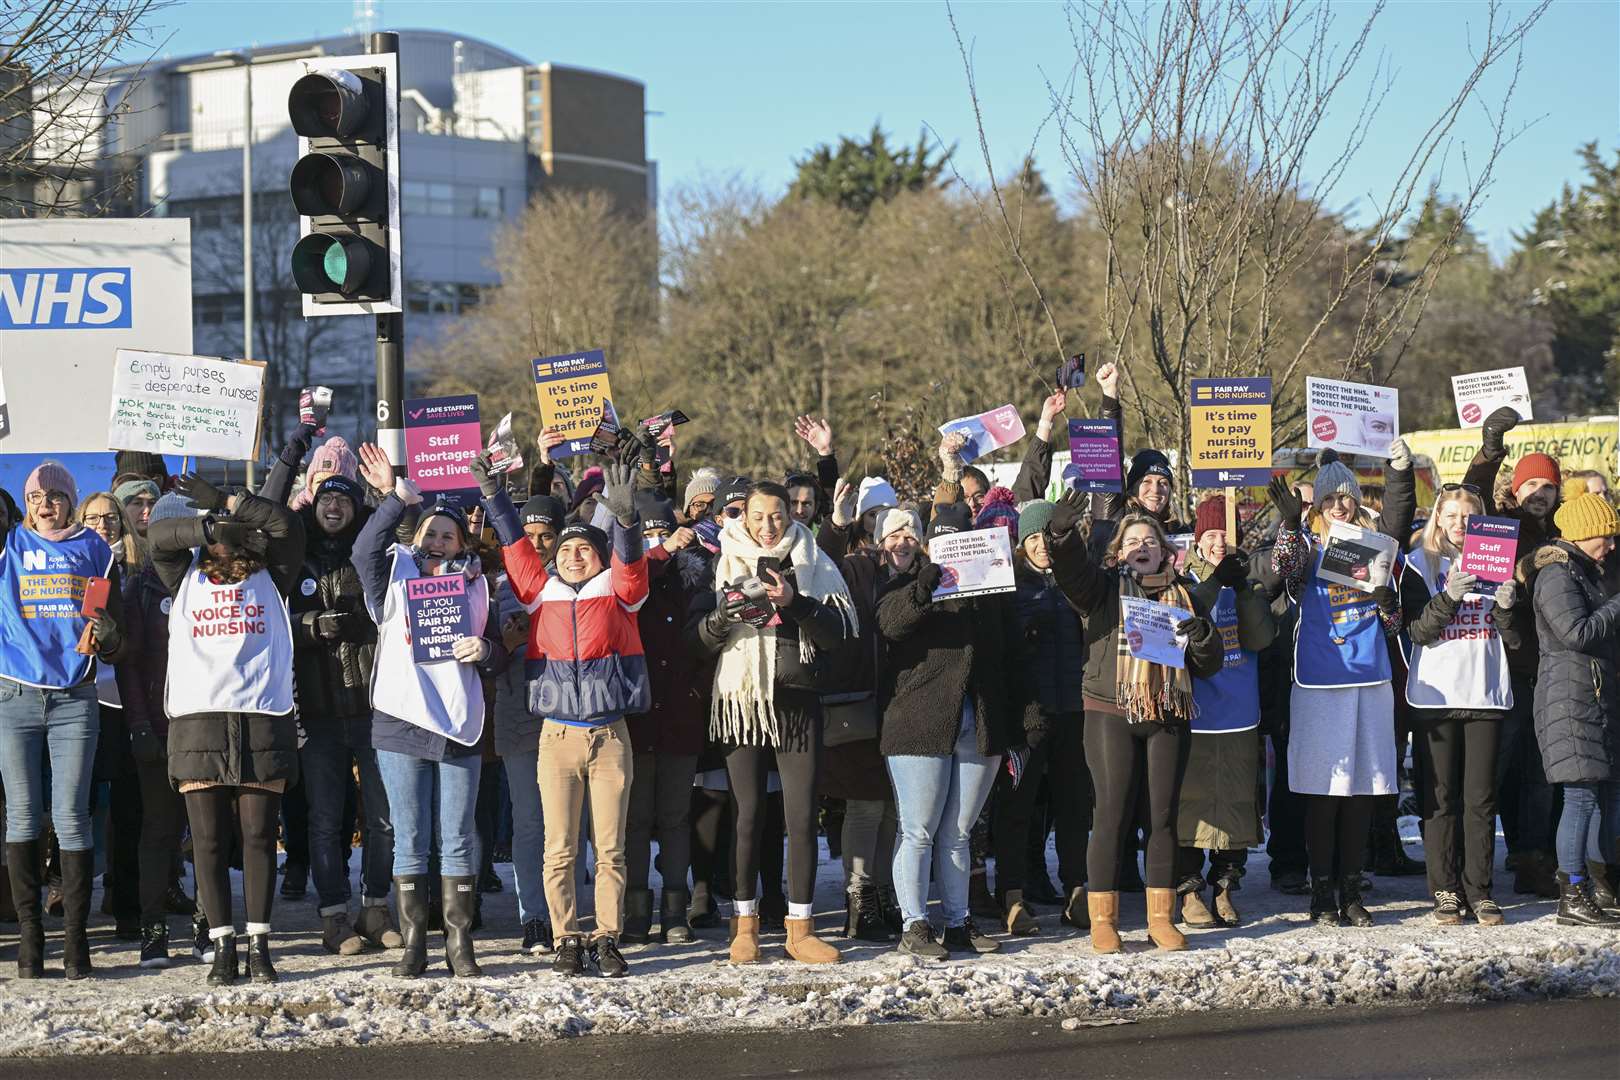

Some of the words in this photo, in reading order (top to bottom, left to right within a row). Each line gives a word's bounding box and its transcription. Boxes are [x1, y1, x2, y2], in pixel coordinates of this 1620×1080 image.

[0, 273, 125, 324] NHS
[570, 362, 602, 372] NURSING
[571, 358, 585, 366] PAY
[130, 360, 171, 380] Empty
[183, 365, 226, 383] purses
[145, 380, 211, 397] desperate
[220, 385, 258, 402] nurses
[548, 385, 567, 396] It's
[570, 382, 598, 393] time
[1312, 383, 1339, 392] PROTECT
[556, 398, 569, 407] to
[573, 395, 594, 406] pay
[1312, 391, 1339, 399] PROTECT
[1341, 394, 1371, 404] NURSING.
[149, 402, 176, 410] Nurse
[377, 400, 390, 421] 6
[426, 406, 443, 414] SAFE
[444, 404, 475, 412] STAFFING
[1312, 398, 1339, 408] PROTECT
[1354, 404, 1378, 413] PUBLIC.
[447, 410, 465, 418] LIVES
[554, 406, 601, 420] nursing
[1205, 411, 1225, 421] It's
[1227, 410, 1258, 420] time
[193, 415, 212, 425] the
[117, 419, 137, 427] risk
[159, 421, 197, 431] patient
[206, 426, 229, 436] care
[1212, 425, 1225, 434] to
[1228, 425, 1251, 435] pay
[428, 434, 460, 447] Staff
[1207, 436, 1256, 448] nursing
[414, 449, 476, 464] shortages
[1199, 449, 1229, 460] staff
[1231, 449, 1265, 460] fairly
[418, 466, 445, 477] cost
[446, 464, 471, 475] live
[1480, 543, 1501, 552] Staff
[1349, 552, 1360, 560] FOR
[1467, 551, 1510, 564] shortages
[1467, 563, 1485, 571] cost
[1488, 564, 1507, 573] lives
[27, 578, 49, 586] THE
[51, 576, 83, 586] VOICE
[22, 588, 37, 597] OF
[412, 580, 460, 595] HONK
[211, 589, 244, 603] THE
[38, 604, 57, 612] FAIR
[423, 599, 431, 608] IF
[433, 597, 453, 607] YOU
[192, 605, 242, 622] VOICE
[245, 604, 265, 618] OF
[417, 606, 462, 618] SUPPORT
[418, 617, 441, 627] FAIR
[443, 615, 462, 625] PAY
[193, 621, 265, 638] NURSING
[431, 625, 452, 635] FOR
[420, 633, 465, 645] NURSING
